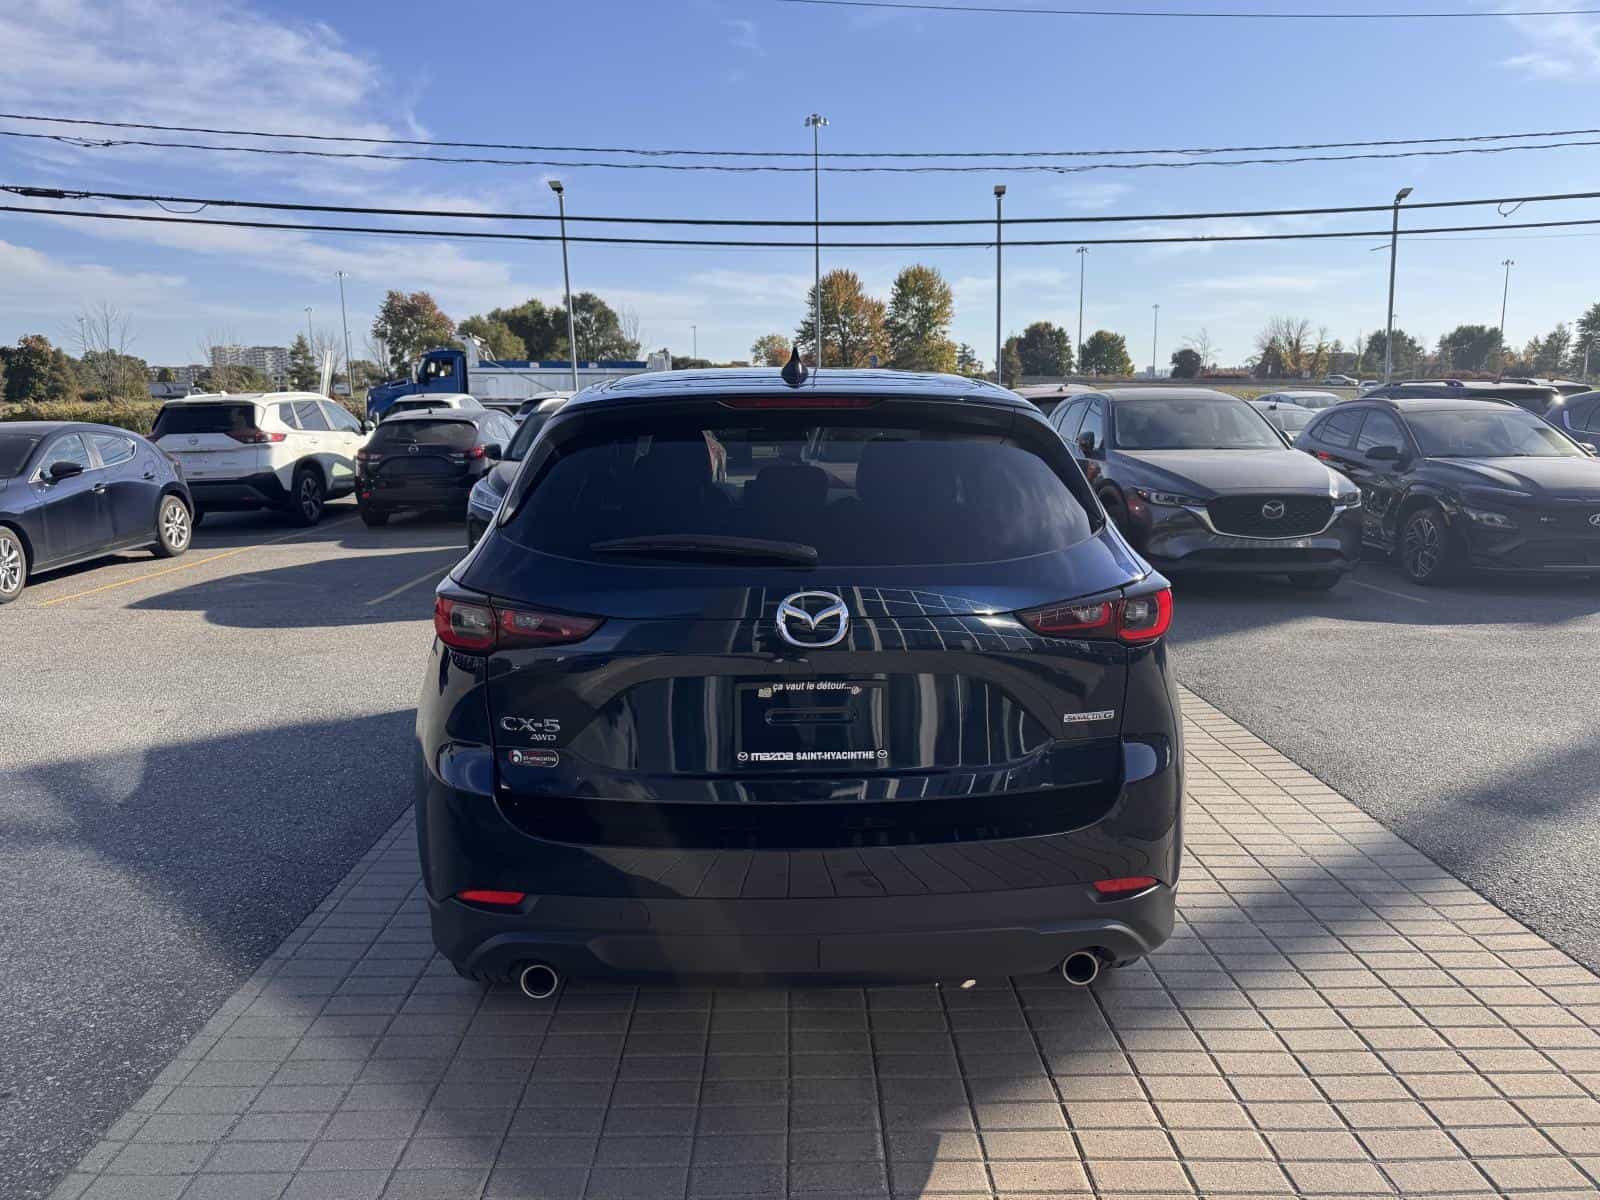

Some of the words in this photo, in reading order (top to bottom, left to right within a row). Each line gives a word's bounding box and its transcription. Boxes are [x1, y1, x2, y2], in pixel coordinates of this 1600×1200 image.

[786, 681, 804, 690] vaut
[806, 680, 815, 690] le
[501, 716, 561, 732] CX-5
[530, 734, 557, 742] AWD
[796, 751, 875, 761] SAINT-HYACINTHE
